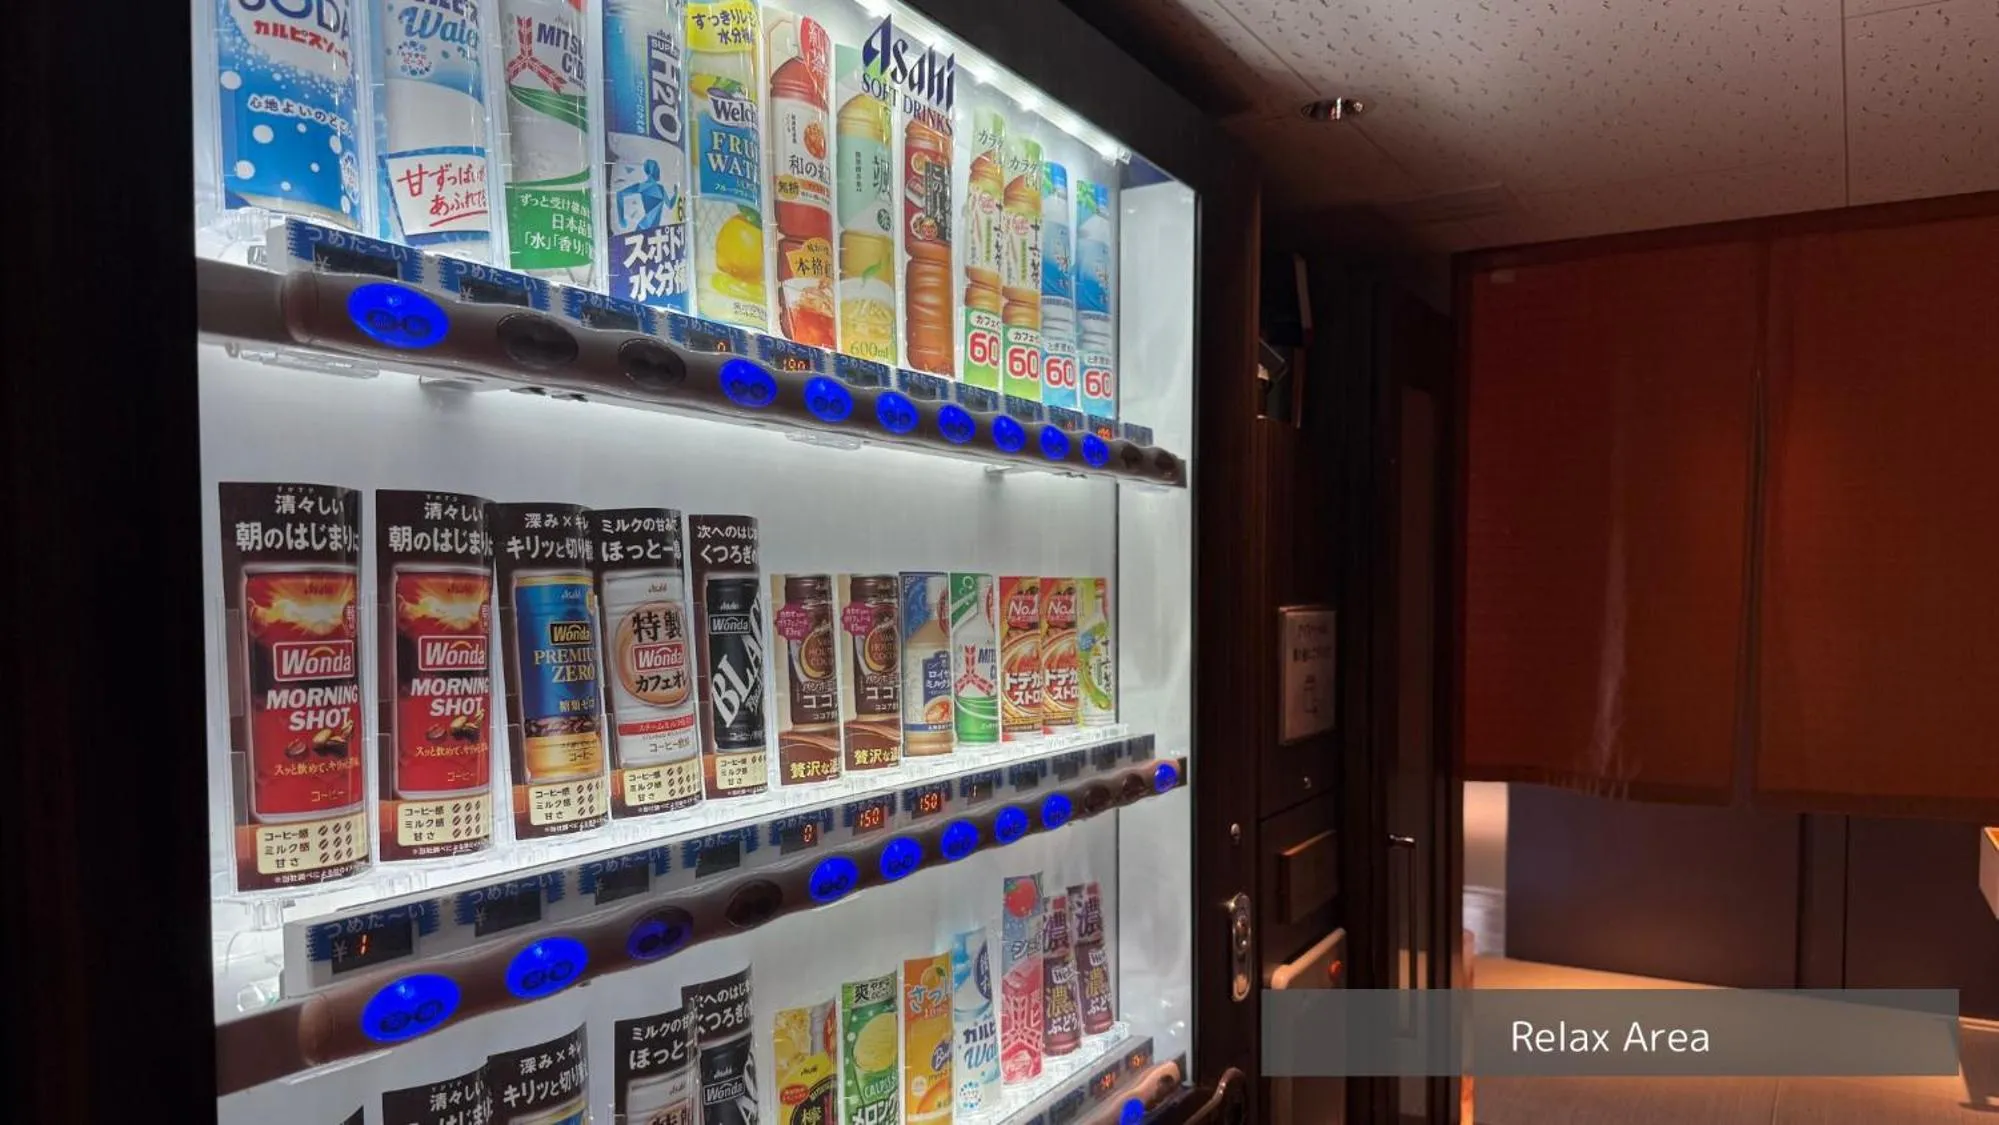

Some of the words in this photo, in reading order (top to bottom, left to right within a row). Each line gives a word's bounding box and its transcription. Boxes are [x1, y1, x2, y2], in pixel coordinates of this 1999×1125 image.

[862, 13, 955, 113] Asahi
[862, 73, 897, 106] SOFT
[903, 94, 953, 136] DRINKS
[275, 494, 344, 515] 清々しい
[424, 501, 483, 521] 清々しい
[713, 617, 749, 631] Wonda
[282, 647, 352, 676] Wonda
[425, 641, 485, 666] Wonda
[639, 646, 683, 669] Wonda
[266, 684, 359, 710] MORNING
[430, 697, 482, 717] SHOT
[288, 707, 351, 731] SHOT
[858, 807, 880, 828] 150
[413, 831, 435, 841] 甘さ
[275, 857, 300, 869] 甘さ
[707, 1084, 744, 1102] Wonda
